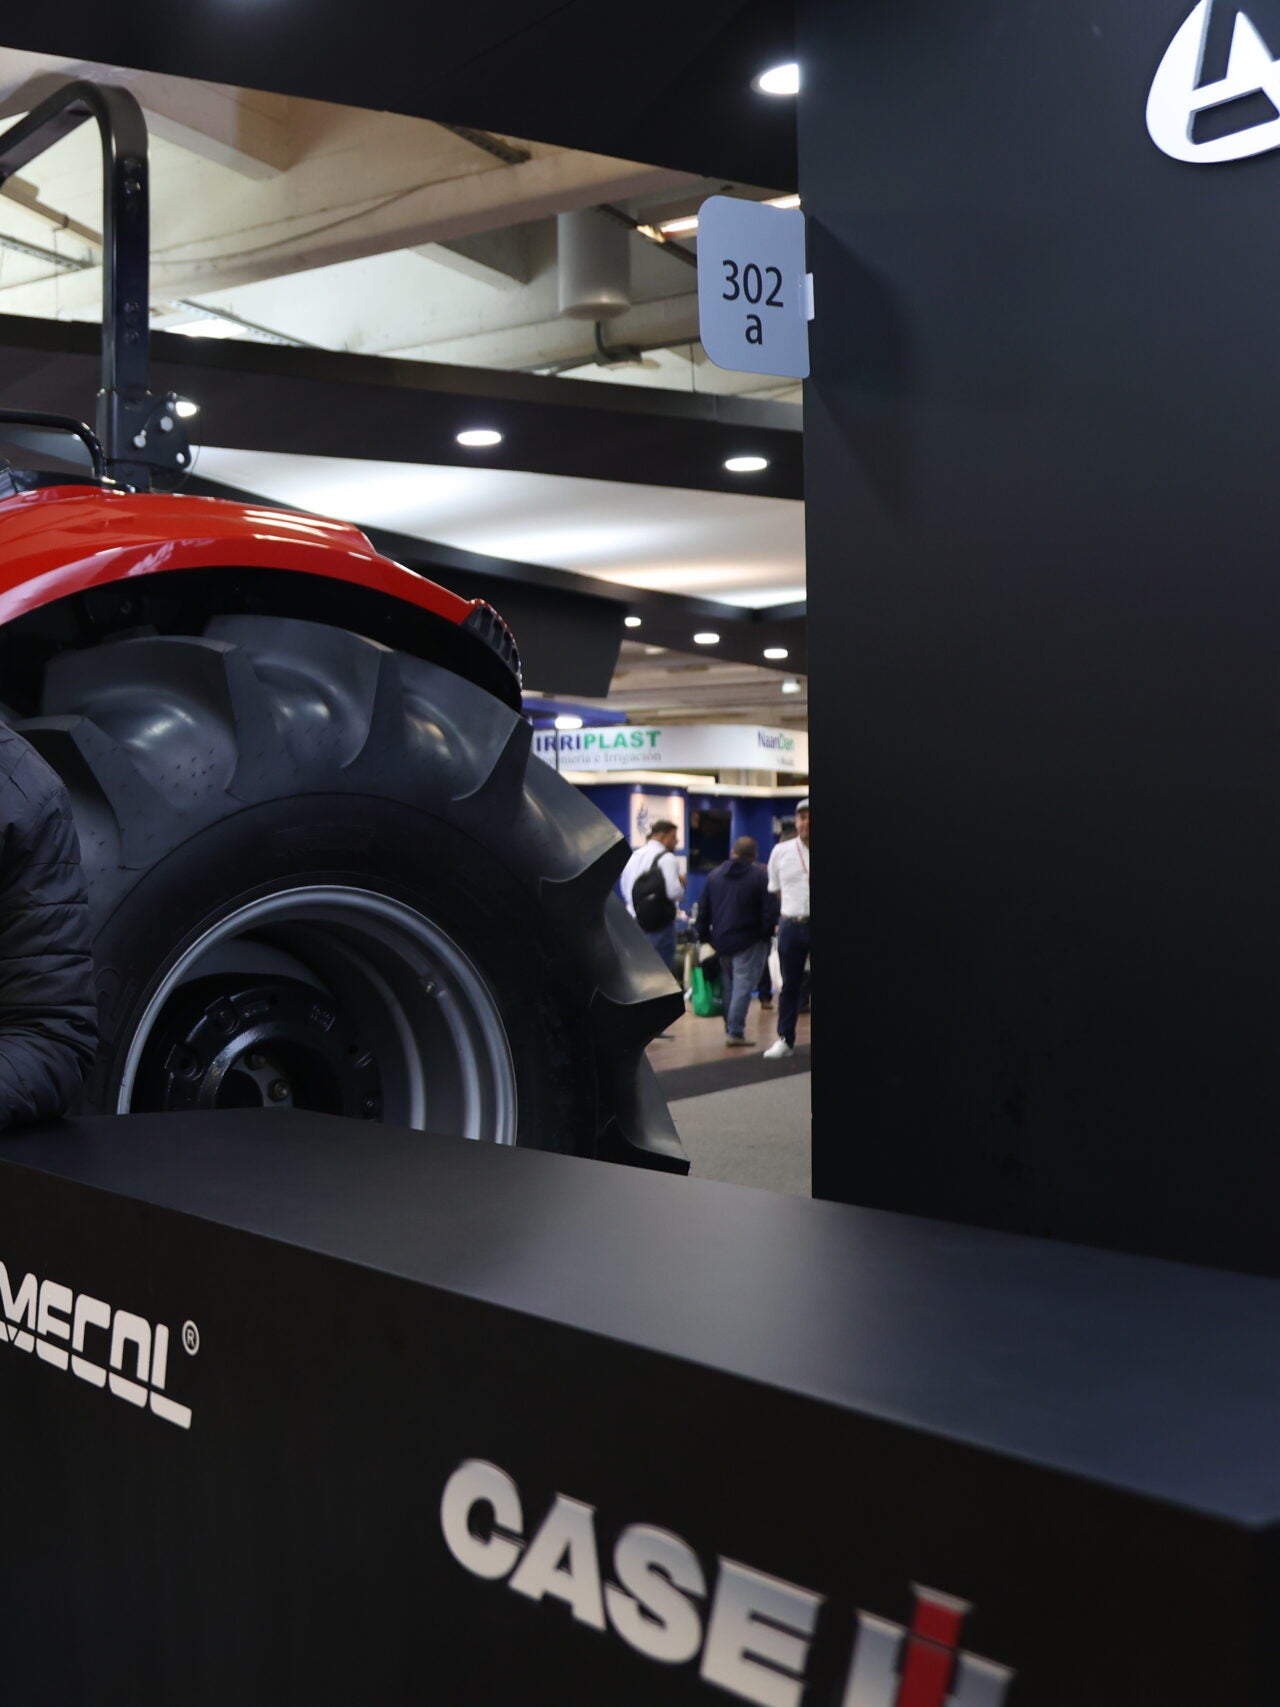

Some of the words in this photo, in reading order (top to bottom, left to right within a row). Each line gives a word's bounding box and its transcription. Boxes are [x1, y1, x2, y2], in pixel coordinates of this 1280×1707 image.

[721, 260, 785, 308] 302
[745, 314, 763, 346] a
[536, 730, 662, 752] IRRIPLAST
[440, 1458, 824, 1707] CASE
